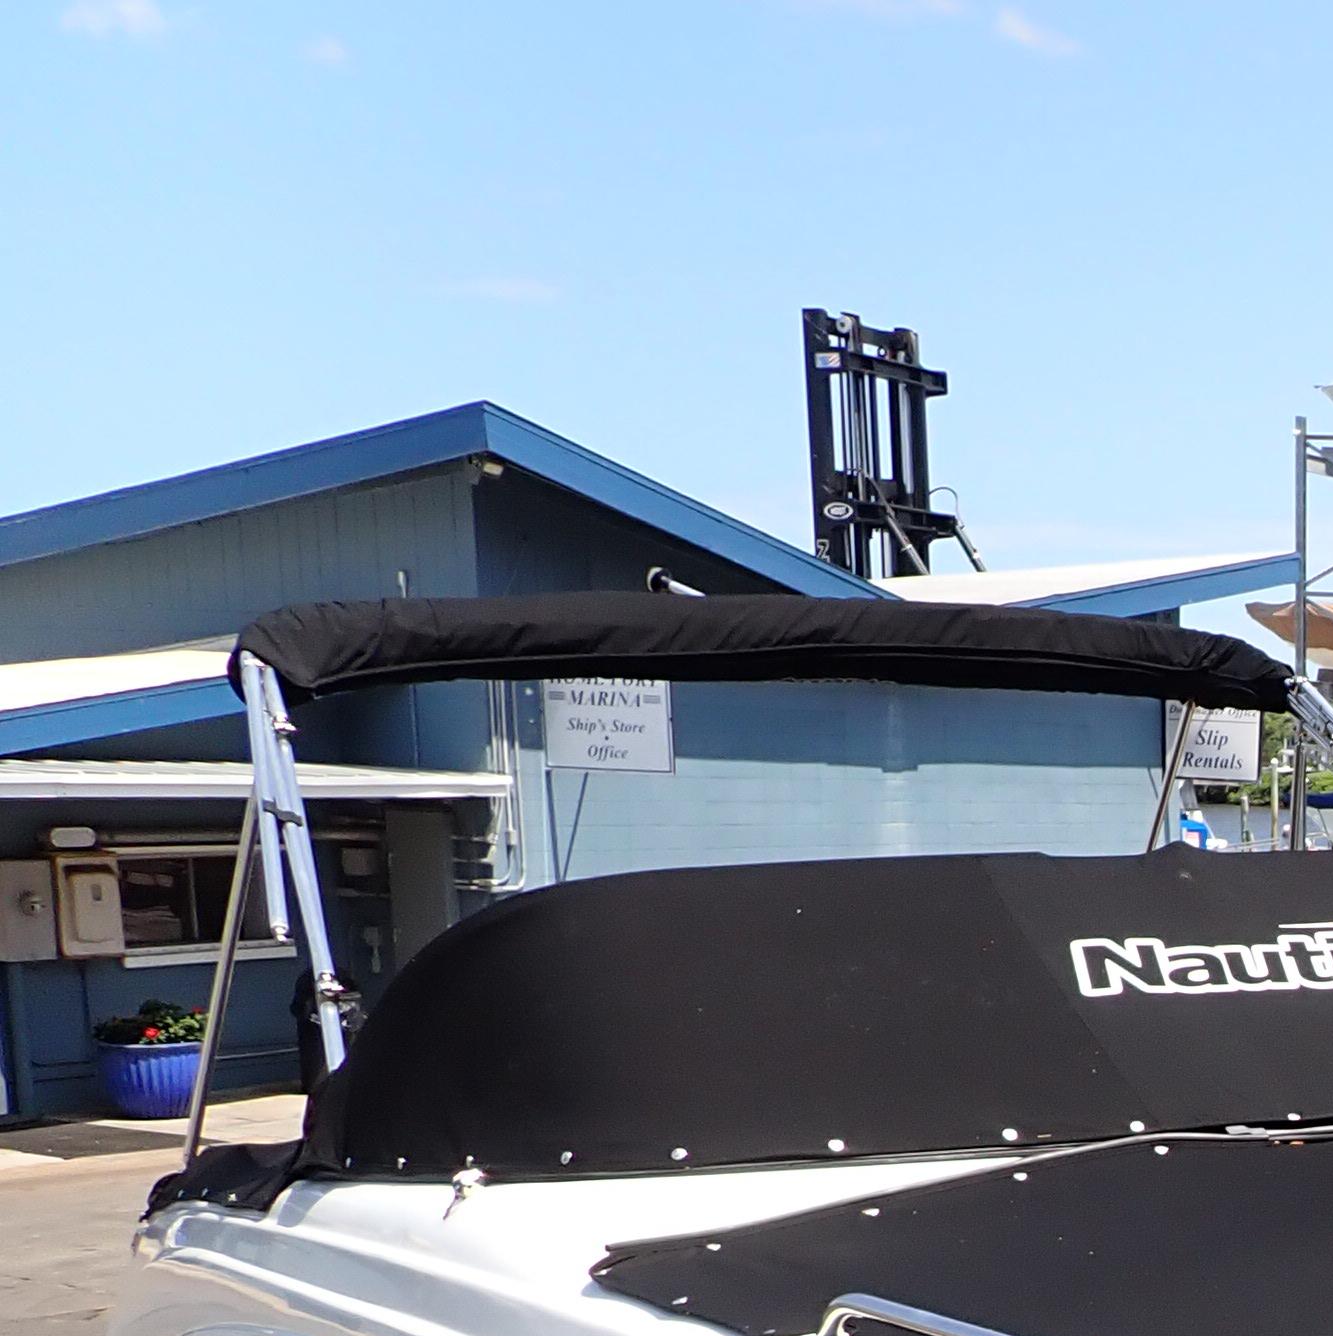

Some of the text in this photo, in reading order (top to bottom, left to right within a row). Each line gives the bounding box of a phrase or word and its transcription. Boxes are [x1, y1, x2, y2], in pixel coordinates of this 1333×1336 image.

[569, 690, 641, 708] MARINA
[566, 717, 646, 736] Ship's Store
[1195, 729, 1229, 751] Slip
[586, 744, 629, 761] Office
[1182, 751, 1244, 770] Rentals
